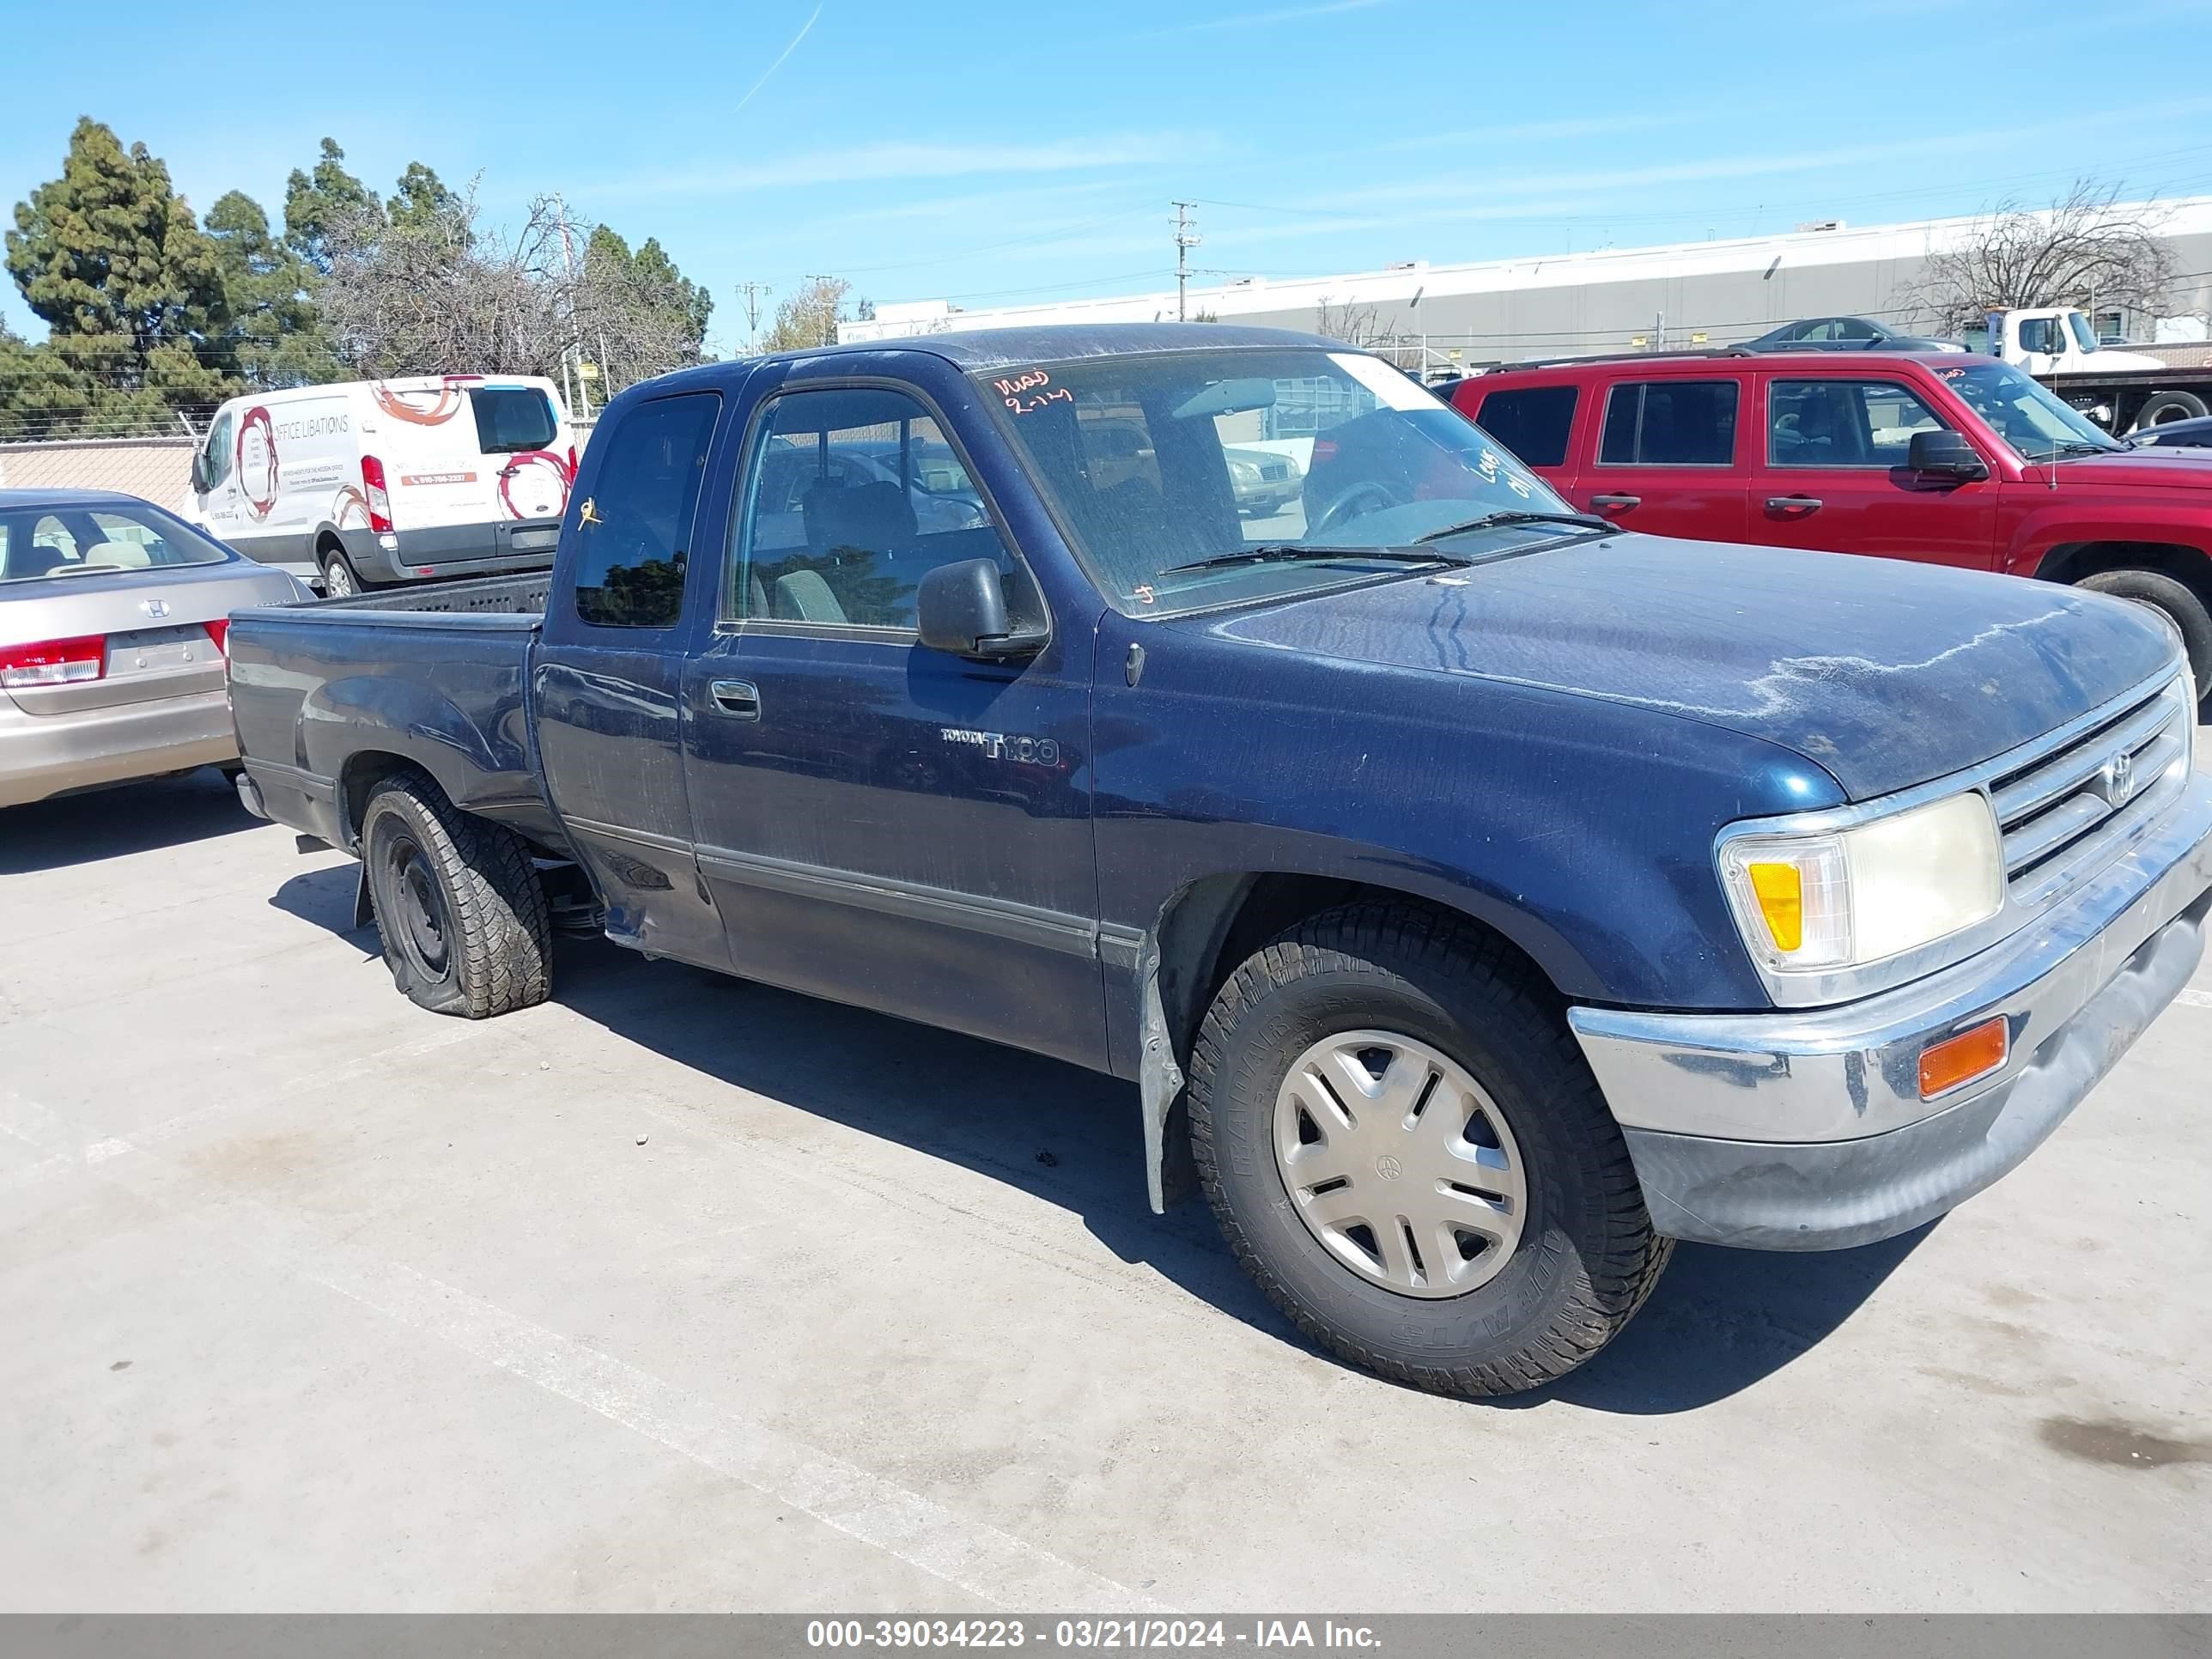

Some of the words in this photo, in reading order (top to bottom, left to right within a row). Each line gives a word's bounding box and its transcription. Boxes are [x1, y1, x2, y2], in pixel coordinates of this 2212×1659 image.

[274, 421, 301, 441] OFFICE
[302, 414, 349, 438] LIBATIONS
[940, 728, 984, 745] TOYOTA
[983, 732, 1060, 767] T100
